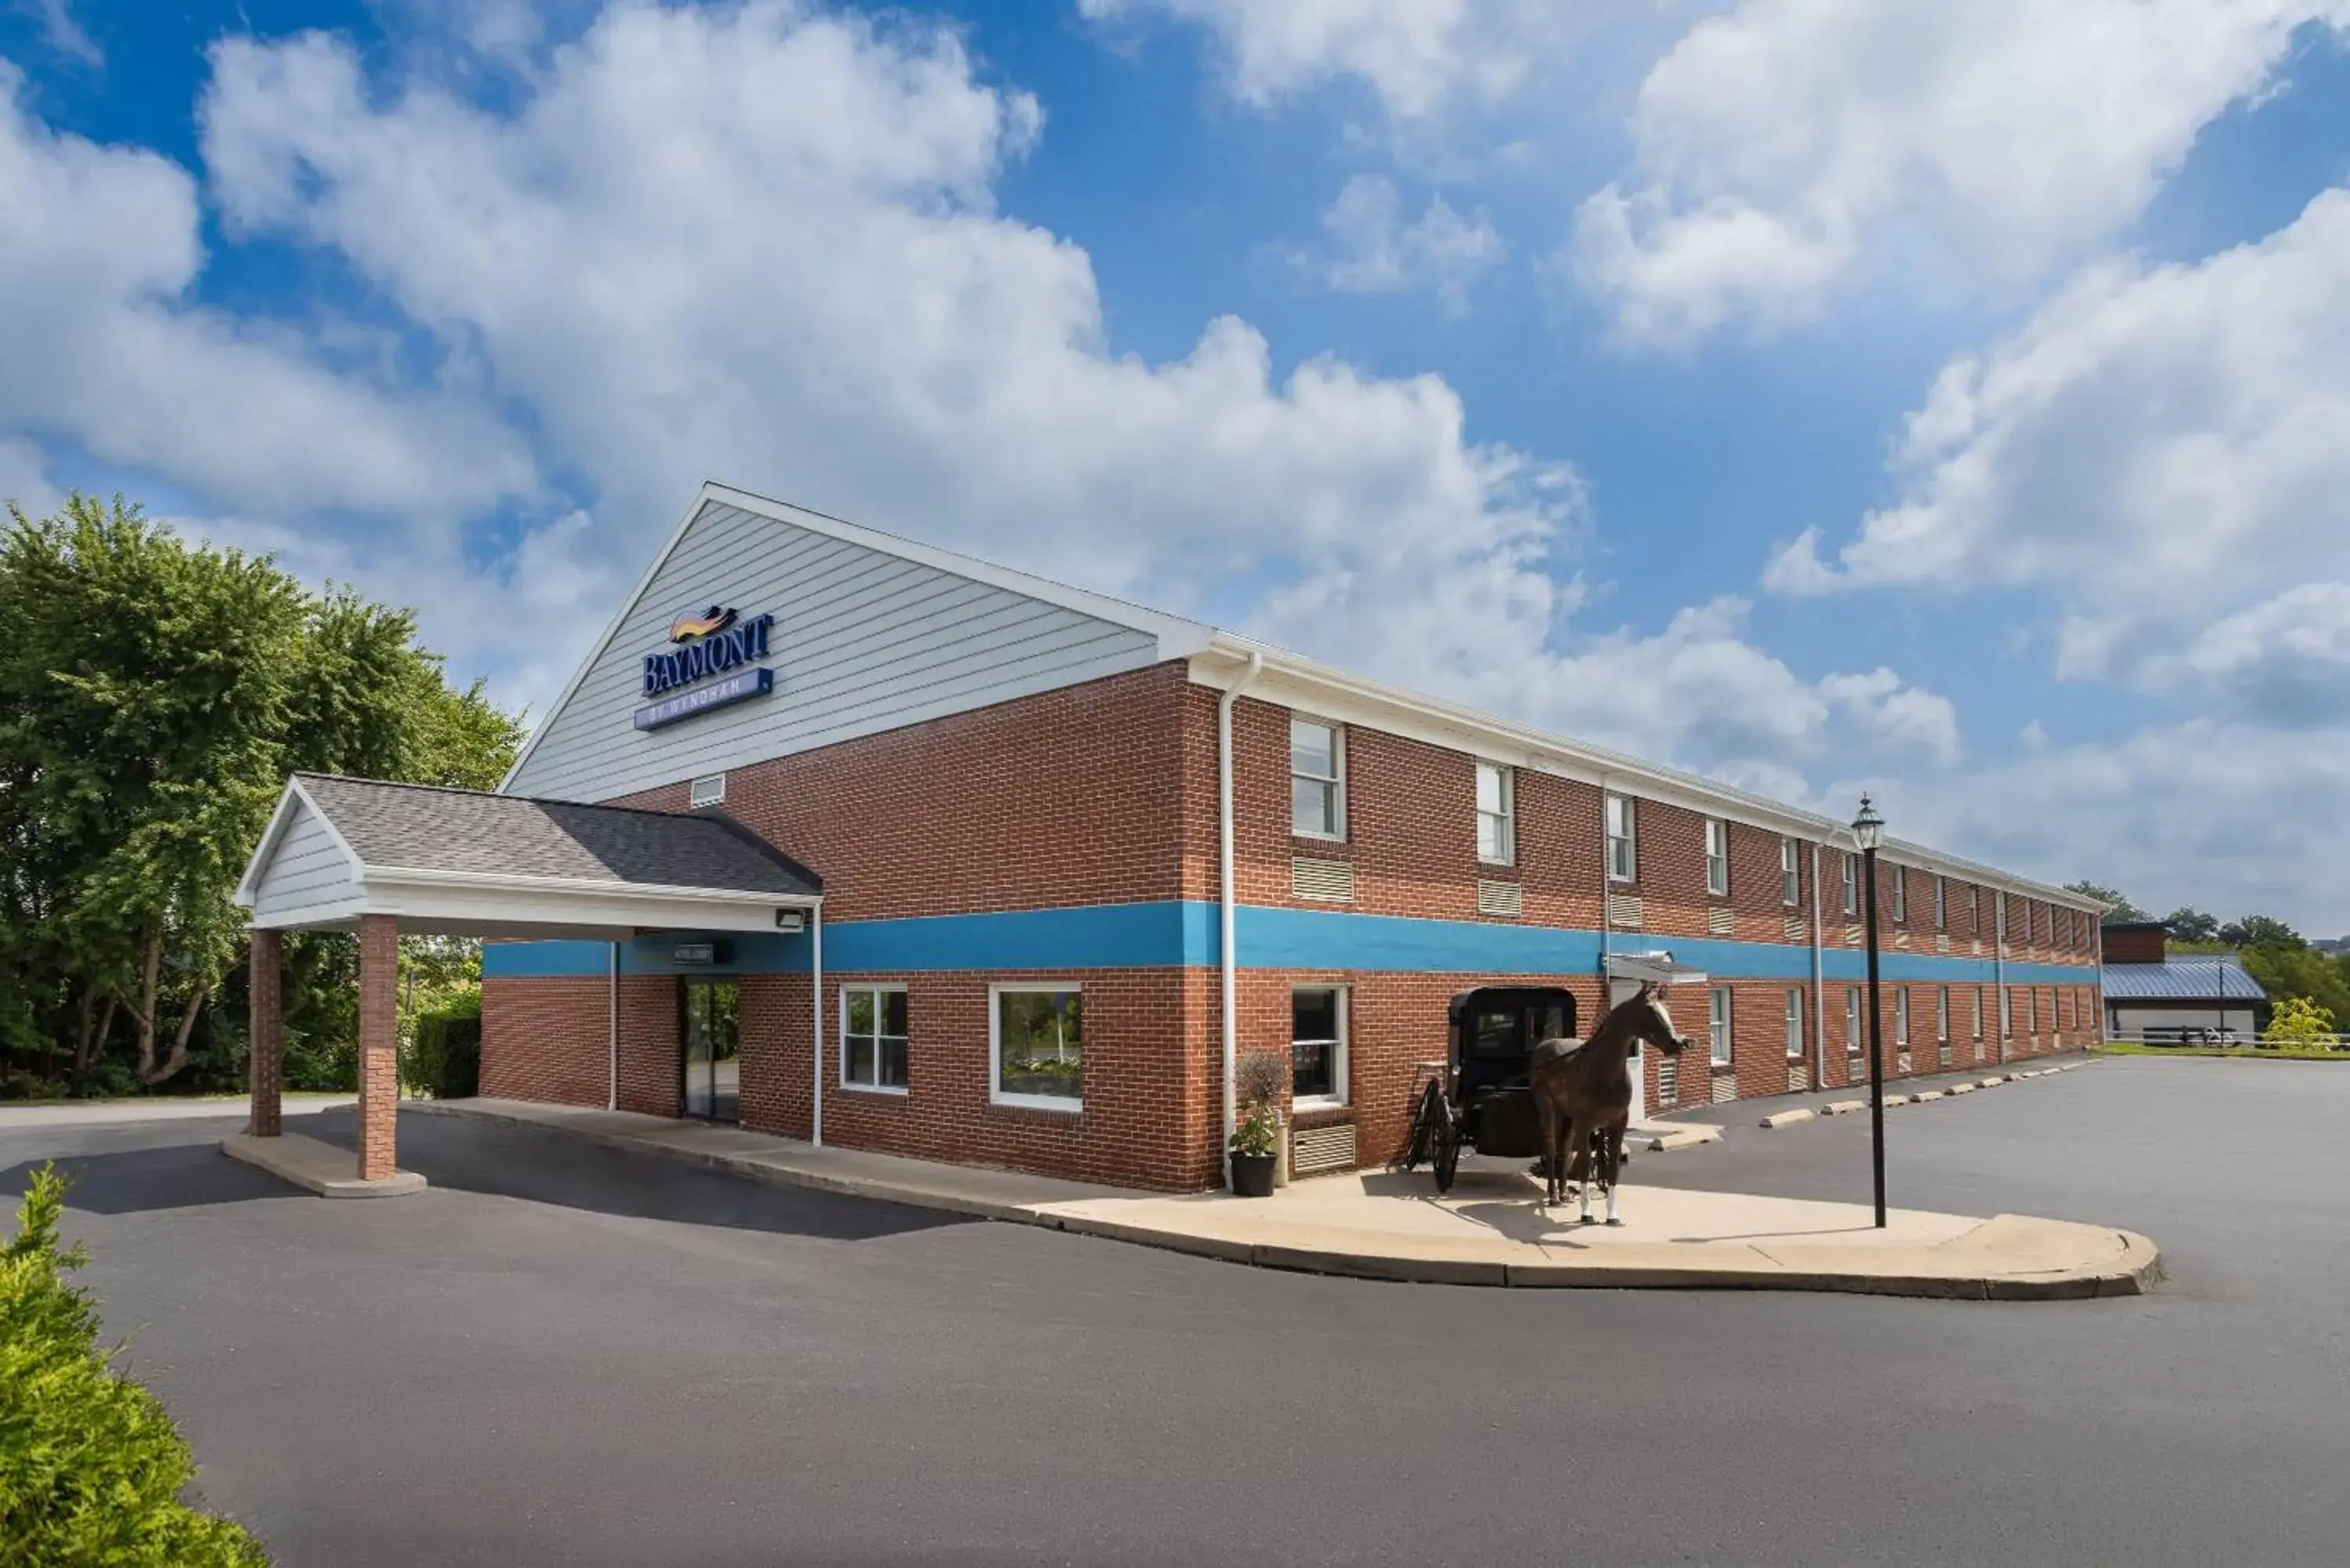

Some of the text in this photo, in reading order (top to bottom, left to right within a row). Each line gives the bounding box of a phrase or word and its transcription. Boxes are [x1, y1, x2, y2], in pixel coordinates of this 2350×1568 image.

[642, 612, 774, 698] BAYMONT
[649, 678, 740, 721] BY WYNDHAM
